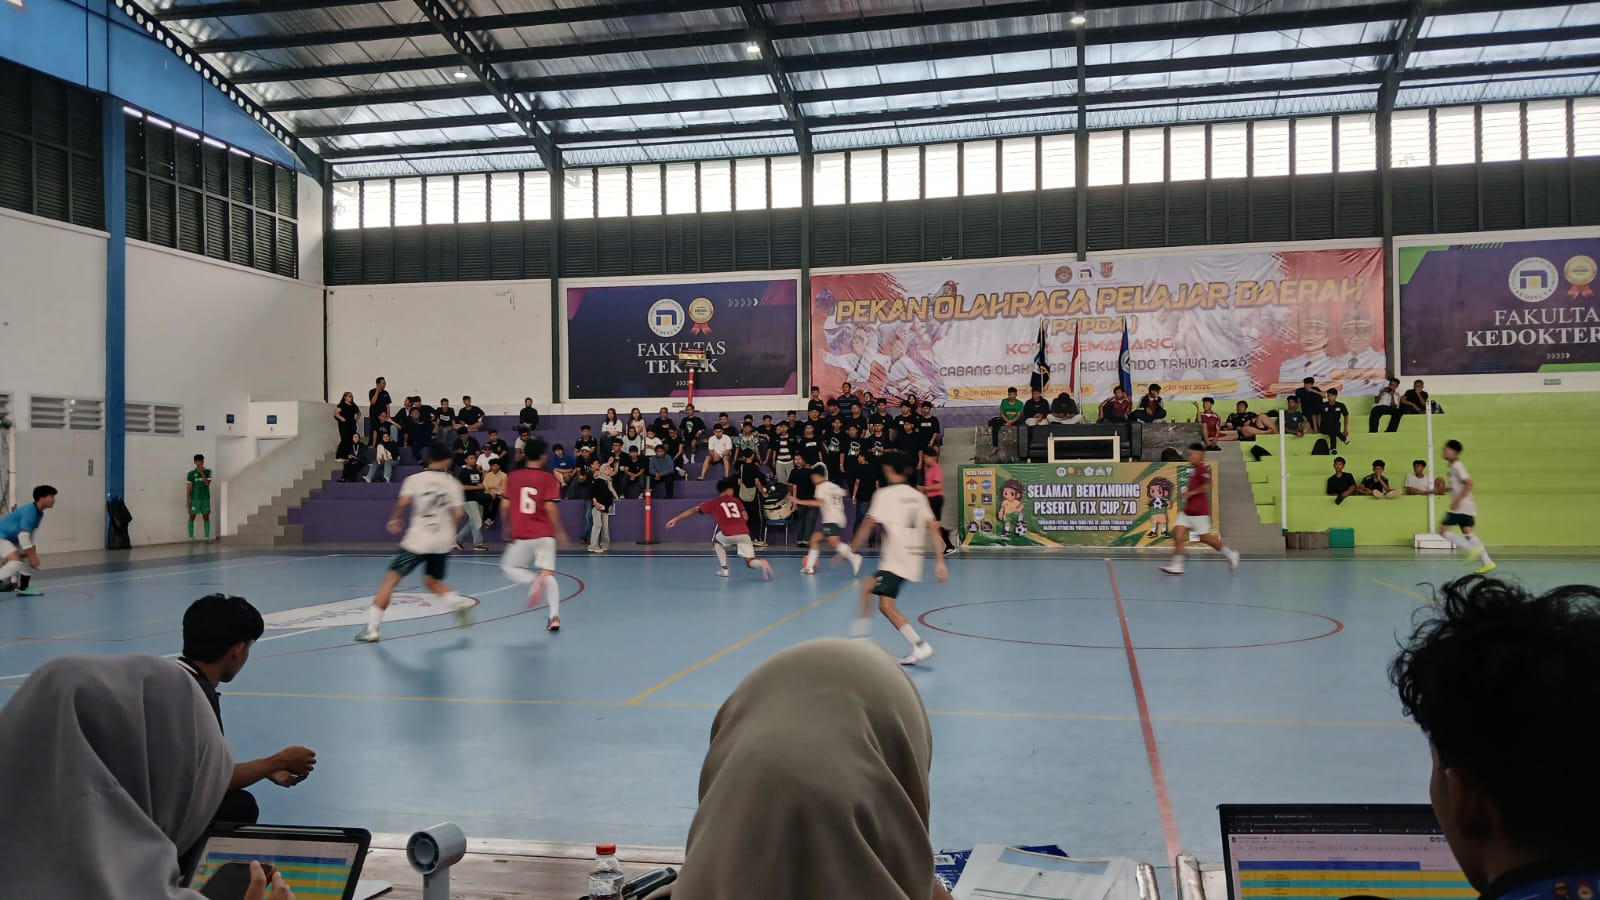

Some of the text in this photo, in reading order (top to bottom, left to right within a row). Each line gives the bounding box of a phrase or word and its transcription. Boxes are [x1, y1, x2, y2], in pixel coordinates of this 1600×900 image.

[835, 278, 1365, 325] PEKAN OLAHRAGA PELAJAR DAERAH
[1061, 336, 1176, 354] SEMAANG
[645, 358, 718, 374] TEKK
[939, 365, 991, 377] CABANG
[1160, 357, 1208, 370] TAHUN
[1027, 483, 1140, 498] SELAMAT BERTANDING
[519, 486, 538, 514] 6
[1034, 500, 1137, 514] PESERTA FIX CUP 7.0
[720, 501, 741, 519] 13
